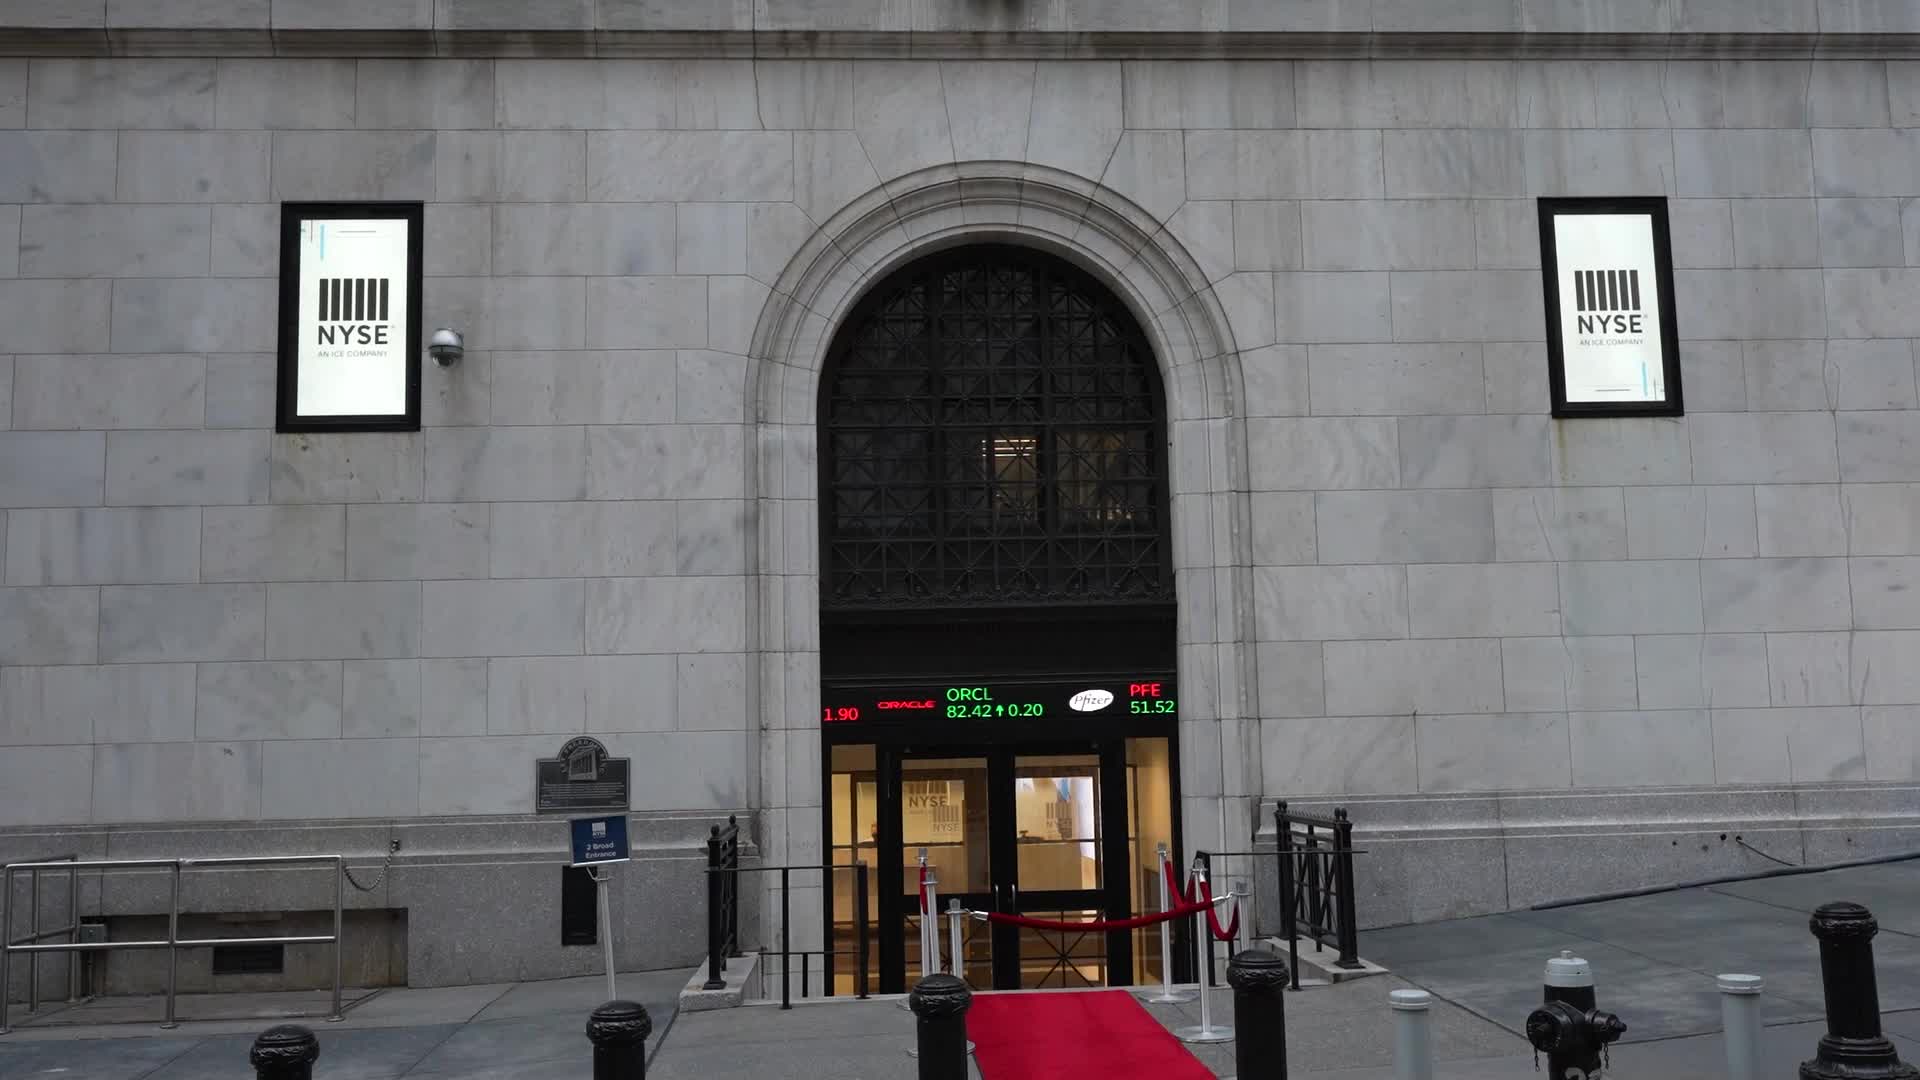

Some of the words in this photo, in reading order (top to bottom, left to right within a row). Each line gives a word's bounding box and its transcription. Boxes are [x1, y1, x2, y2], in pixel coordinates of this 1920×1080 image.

[1578, 314, 1642, 334] NYSE
[318, 325, 388, 345] NYSE
[946, 687, 993, 702] ORCL
[1130, 683, 1161, 697] PFE
[878, 701, 936, 709] ORACLE
[1074, 693, 1110, 712] Pfizer
[1130, 700, 1175, 714] 51.52
[824, 707, 858, 721] 1.90
[946, 704, 992, 718] 82.42
[1008, 703, 1043, 717] 0.20
[909, 795, 948, 808] NYSE
[933, 823, 960, 832] NYSE
[592, 842, 614, 850] Broad
[585, 851, 617, 859] Entrance
